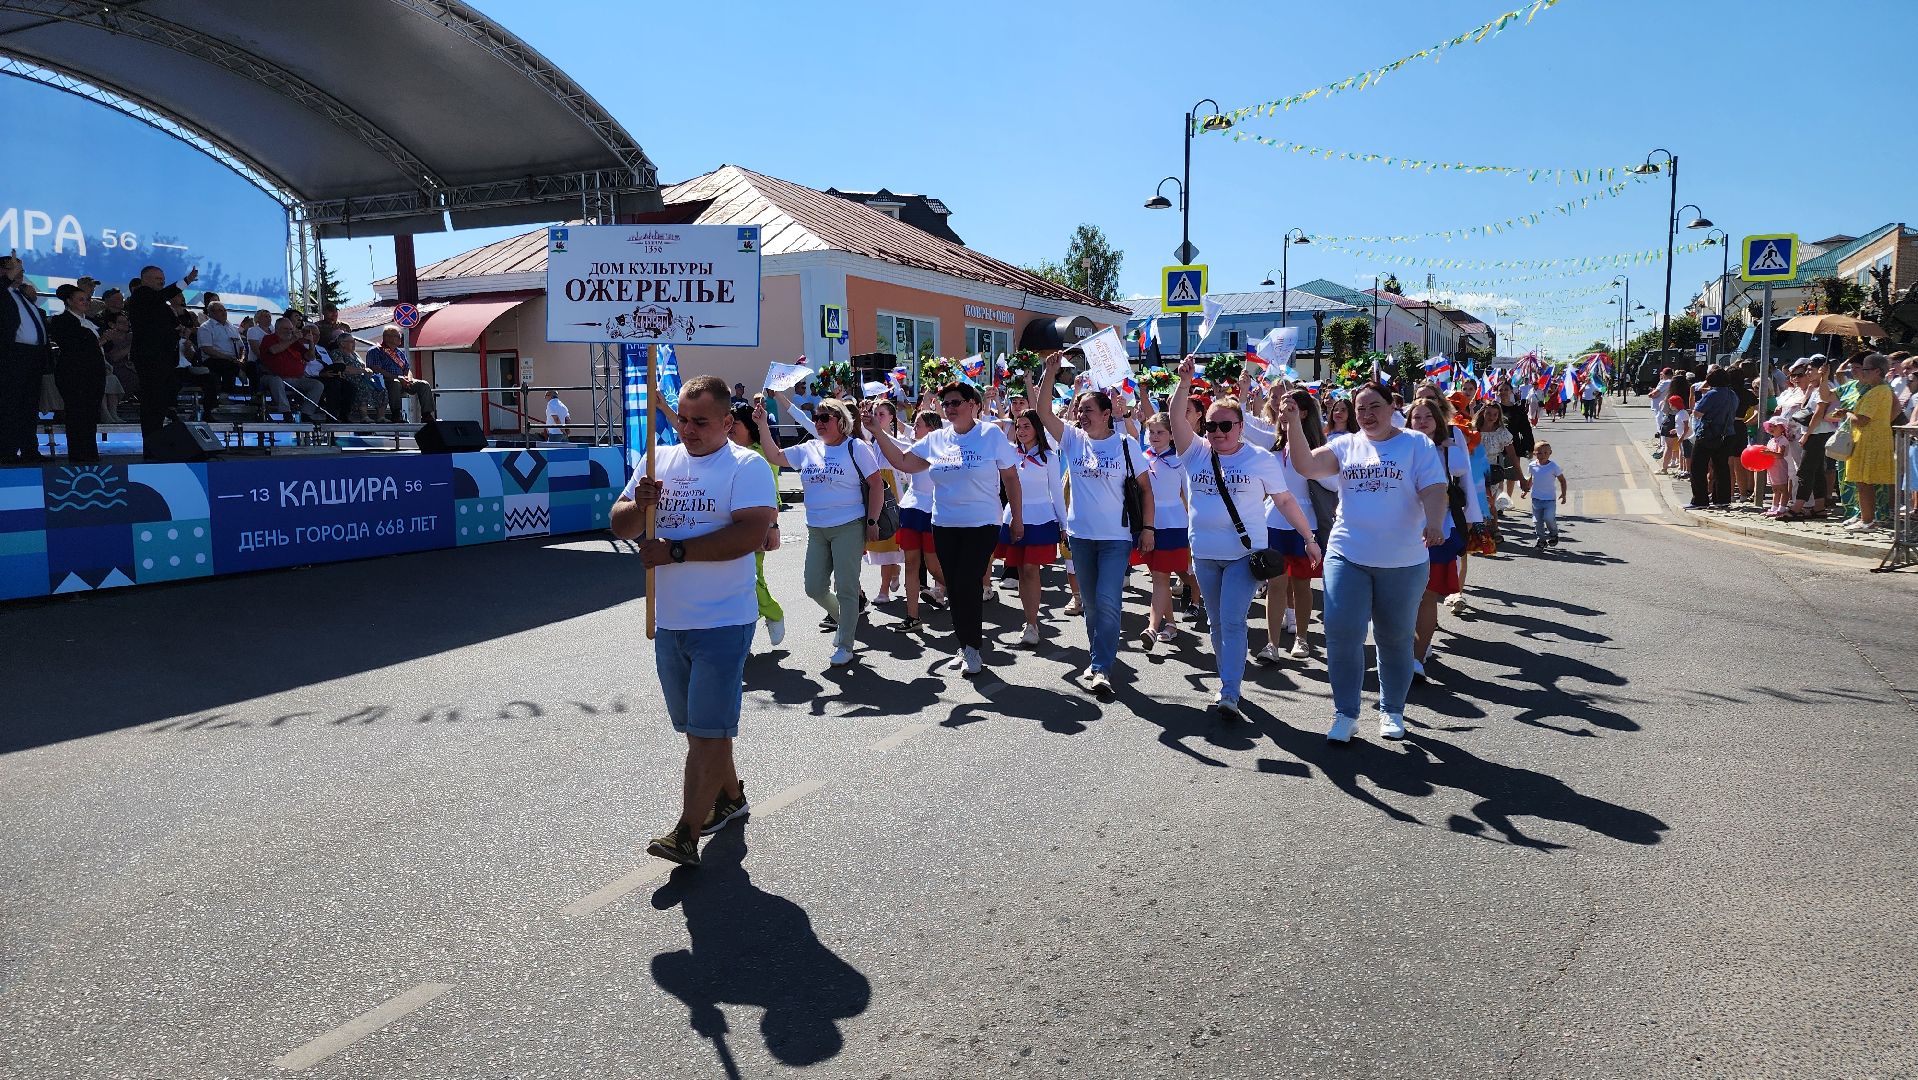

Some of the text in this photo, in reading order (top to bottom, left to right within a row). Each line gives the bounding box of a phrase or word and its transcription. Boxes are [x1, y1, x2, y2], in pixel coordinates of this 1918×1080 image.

[101, 228, 138, 251] 56
[589, 262, 714, 278] ДОМ КУЛЬТУРЫ
[565, 278, 736, 303] ОЖЕРЕЛЬЕ
[964, 304, 1016, 325] КОВРЫ ОБОИ
[1343, 467, 1404, 481] ОЖЕРЕЛЬЕ
[249, 476, 423, 508] 13 КАШИРА 56
[238, 515, 438, 553] ДЕНЬ ГОРОДА 668 ЛЕТ
